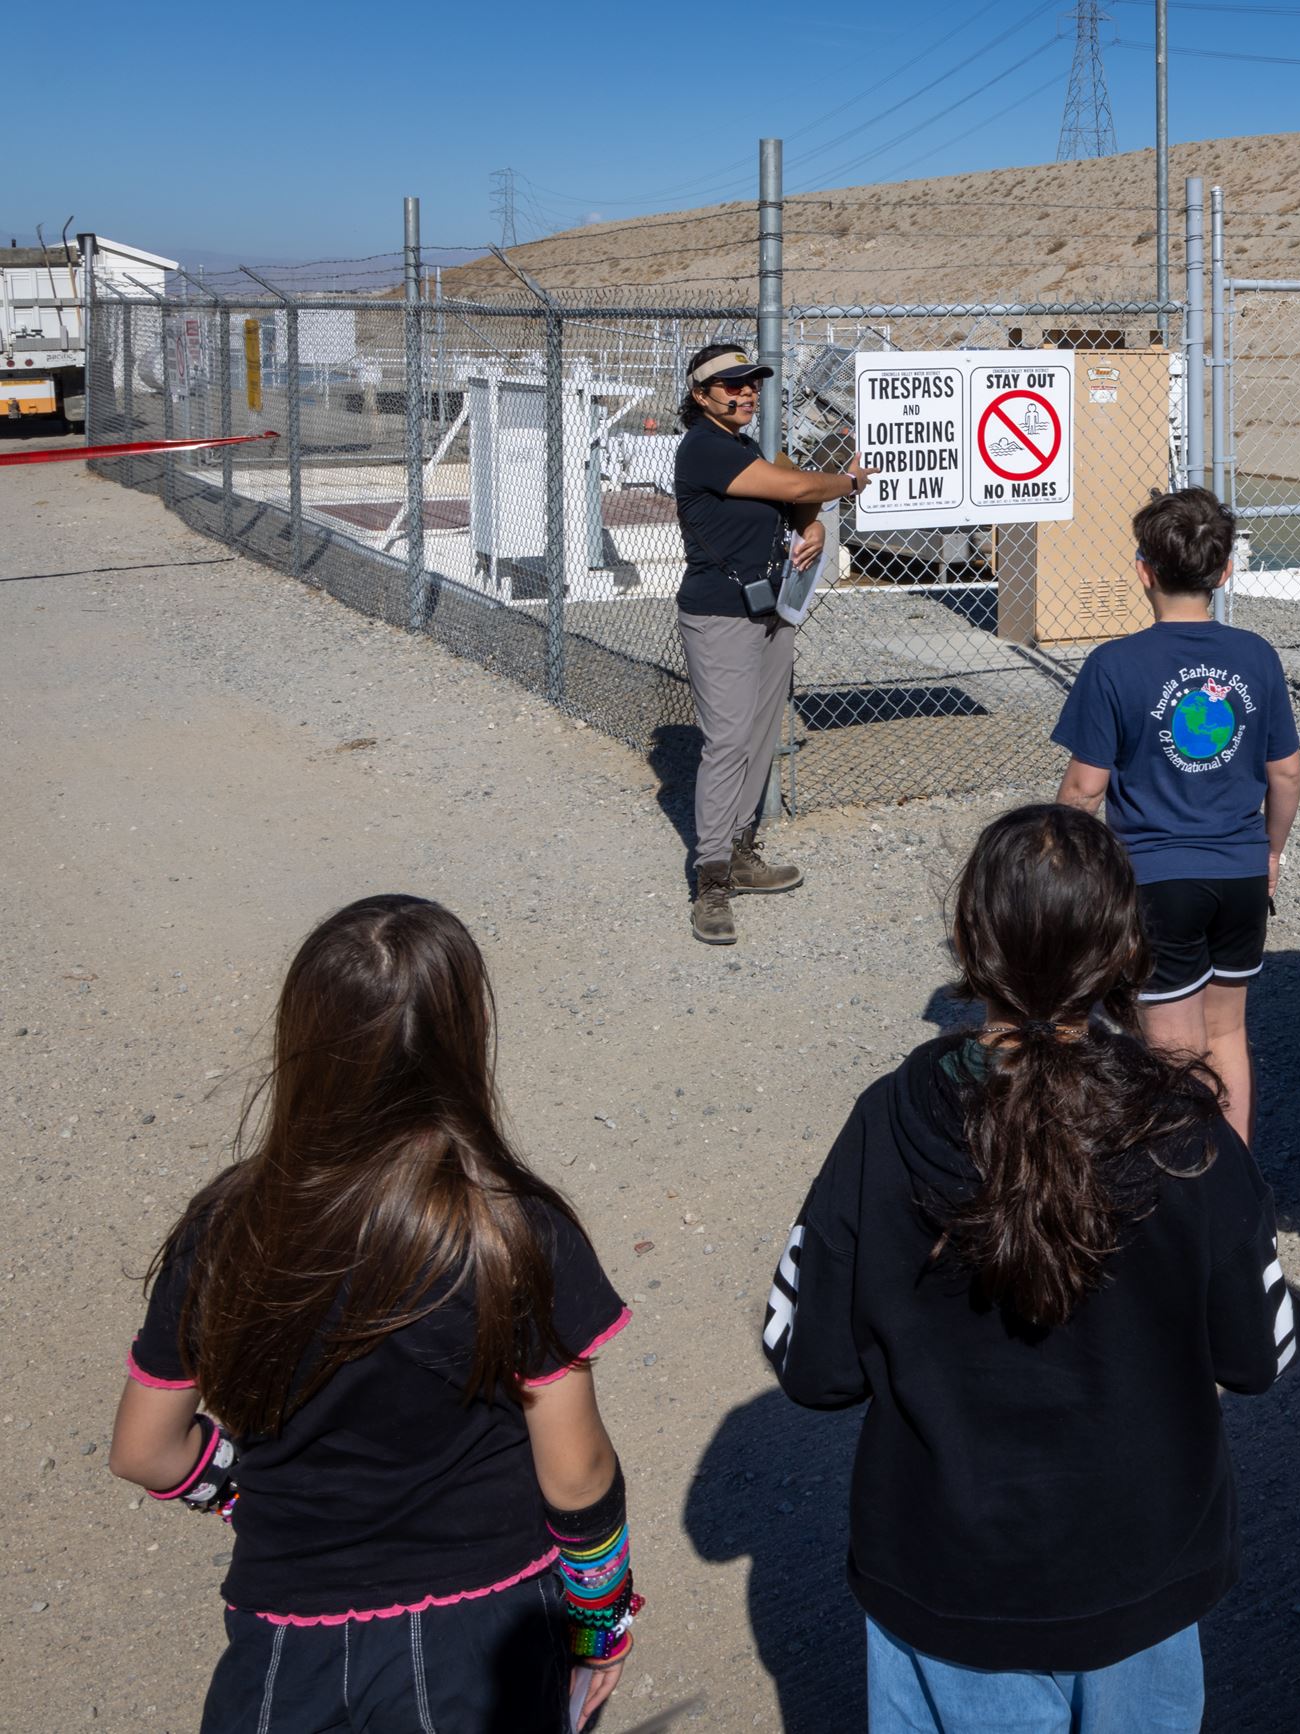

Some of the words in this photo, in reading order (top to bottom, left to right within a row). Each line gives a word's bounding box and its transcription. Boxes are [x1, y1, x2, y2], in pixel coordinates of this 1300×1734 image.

[868, 376, 954, 400] TRESPASS
[986, 374, 1020, 389] STAY
[1027, 373, 1055, 388] OUT
[903, 404, 920, 416] AND
[867, 420, 955, 445] LOITERING
[864, 448, 958, 473] FORBIDDEN
[879, 478, 899, 502] BY
[908, 476, 944, 500] LAW
[984, 483, 1004, 500] NO
[1011, 481, 1057, 498] NADES
[1150, 678, 1179, 720] Amelia
[1179, 664, 1228, 682] Earhart
[1228, 674, 1257, 714] School
[1159, 730, 1173, 743] Of
[1221, 725, 1246, 762] Studies
[1163, 745, 1222, 773] International
